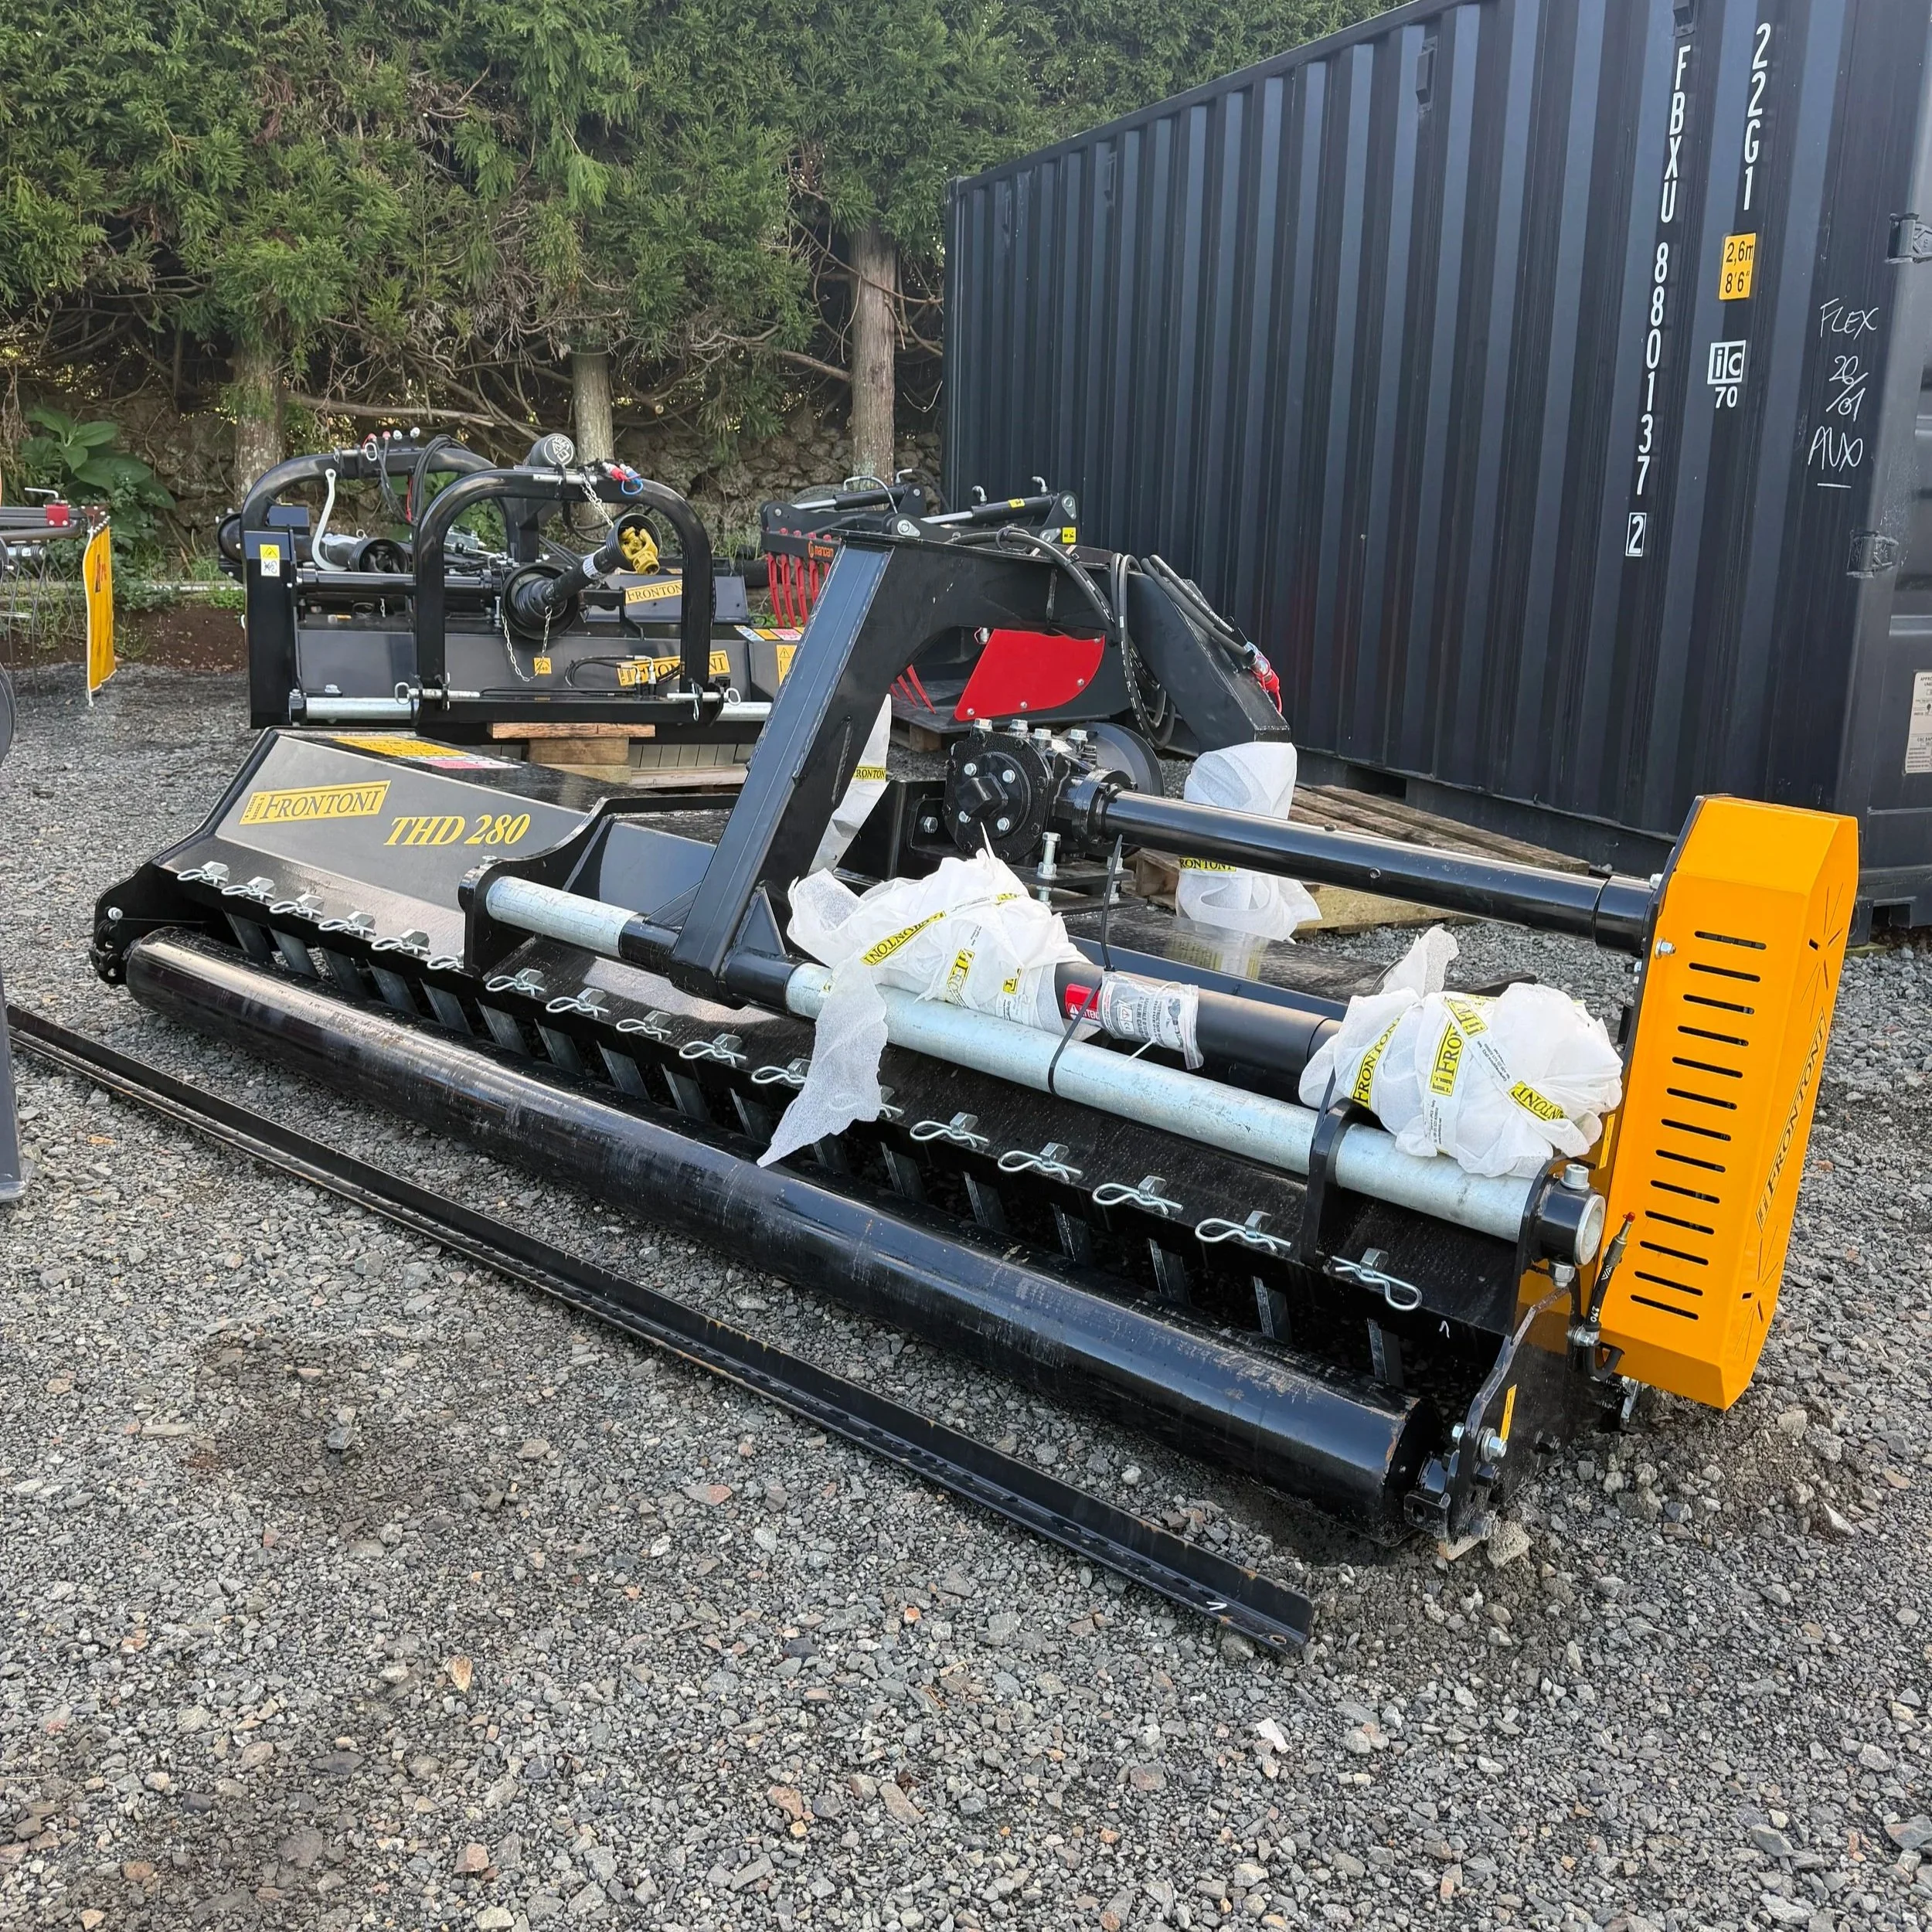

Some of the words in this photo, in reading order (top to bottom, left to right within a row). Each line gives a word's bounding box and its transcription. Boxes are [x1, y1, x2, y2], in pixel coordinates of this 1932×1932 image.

[1660, 44, 1692, 224] FBXU
[1743, 22, 1771, 211] 22G1
[1726, 240, 1754, 267] 2,6m
[1819, 298, 1879, 341] FLEX
[1636, 241, 1669, 495] 880137
[1714, 386, 1738, 408] 70
[1628, 513, 1645, 556] 2
[260, 790, 381, 820] FRONTONI
[384, 815, 465, 846] THD
[464, 813, 530, 845] 280
[1767, 1026, 1825, 1197] FRONTONI
